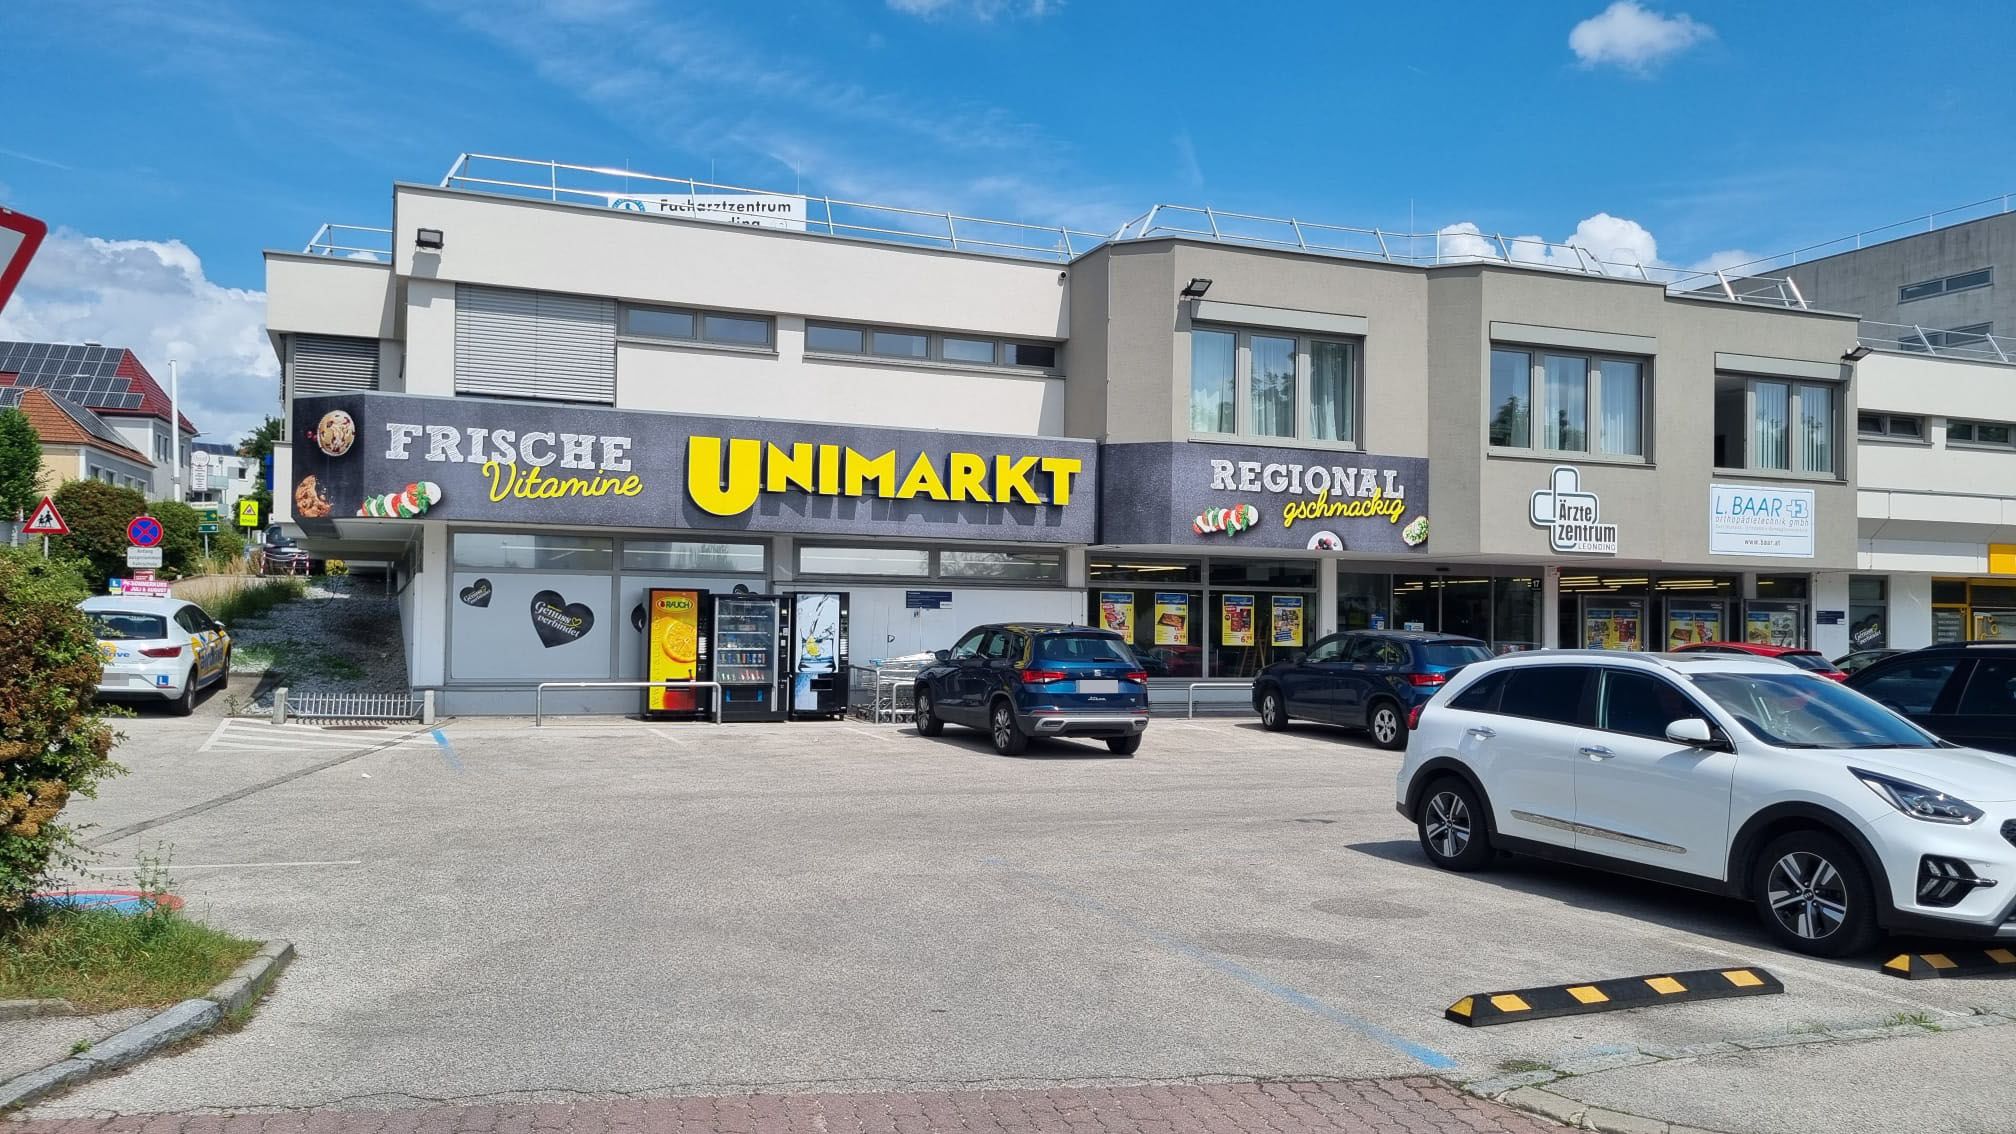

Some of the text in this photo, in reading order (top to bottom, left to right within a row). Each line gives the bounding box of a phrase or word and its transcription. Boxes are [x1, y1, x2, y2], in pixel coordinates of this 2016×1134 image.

[385, 423, 632, 472] FRISCHE
[482, 460, 643, 502] Vitamine
[689, 436, 1082, 516] UNIMARKT
[1210, 459, 1405, 499] REGIONAL
[1283, 487, 1405, 528] gschmackig
[1559, 499, 1592, 522] Ärzte
[1732, 495, 1783, 518] BAAR
[1558, 524, 1616, 543] zentrum
[1578, 542, 1616, 551] LEONDING
[1533, 580, 1540, 588] 17
[535, 601, 571, 624] Genuss
[666, 600, 690, 609] RAUCH
[537, 615, 580, 637] verbindet
